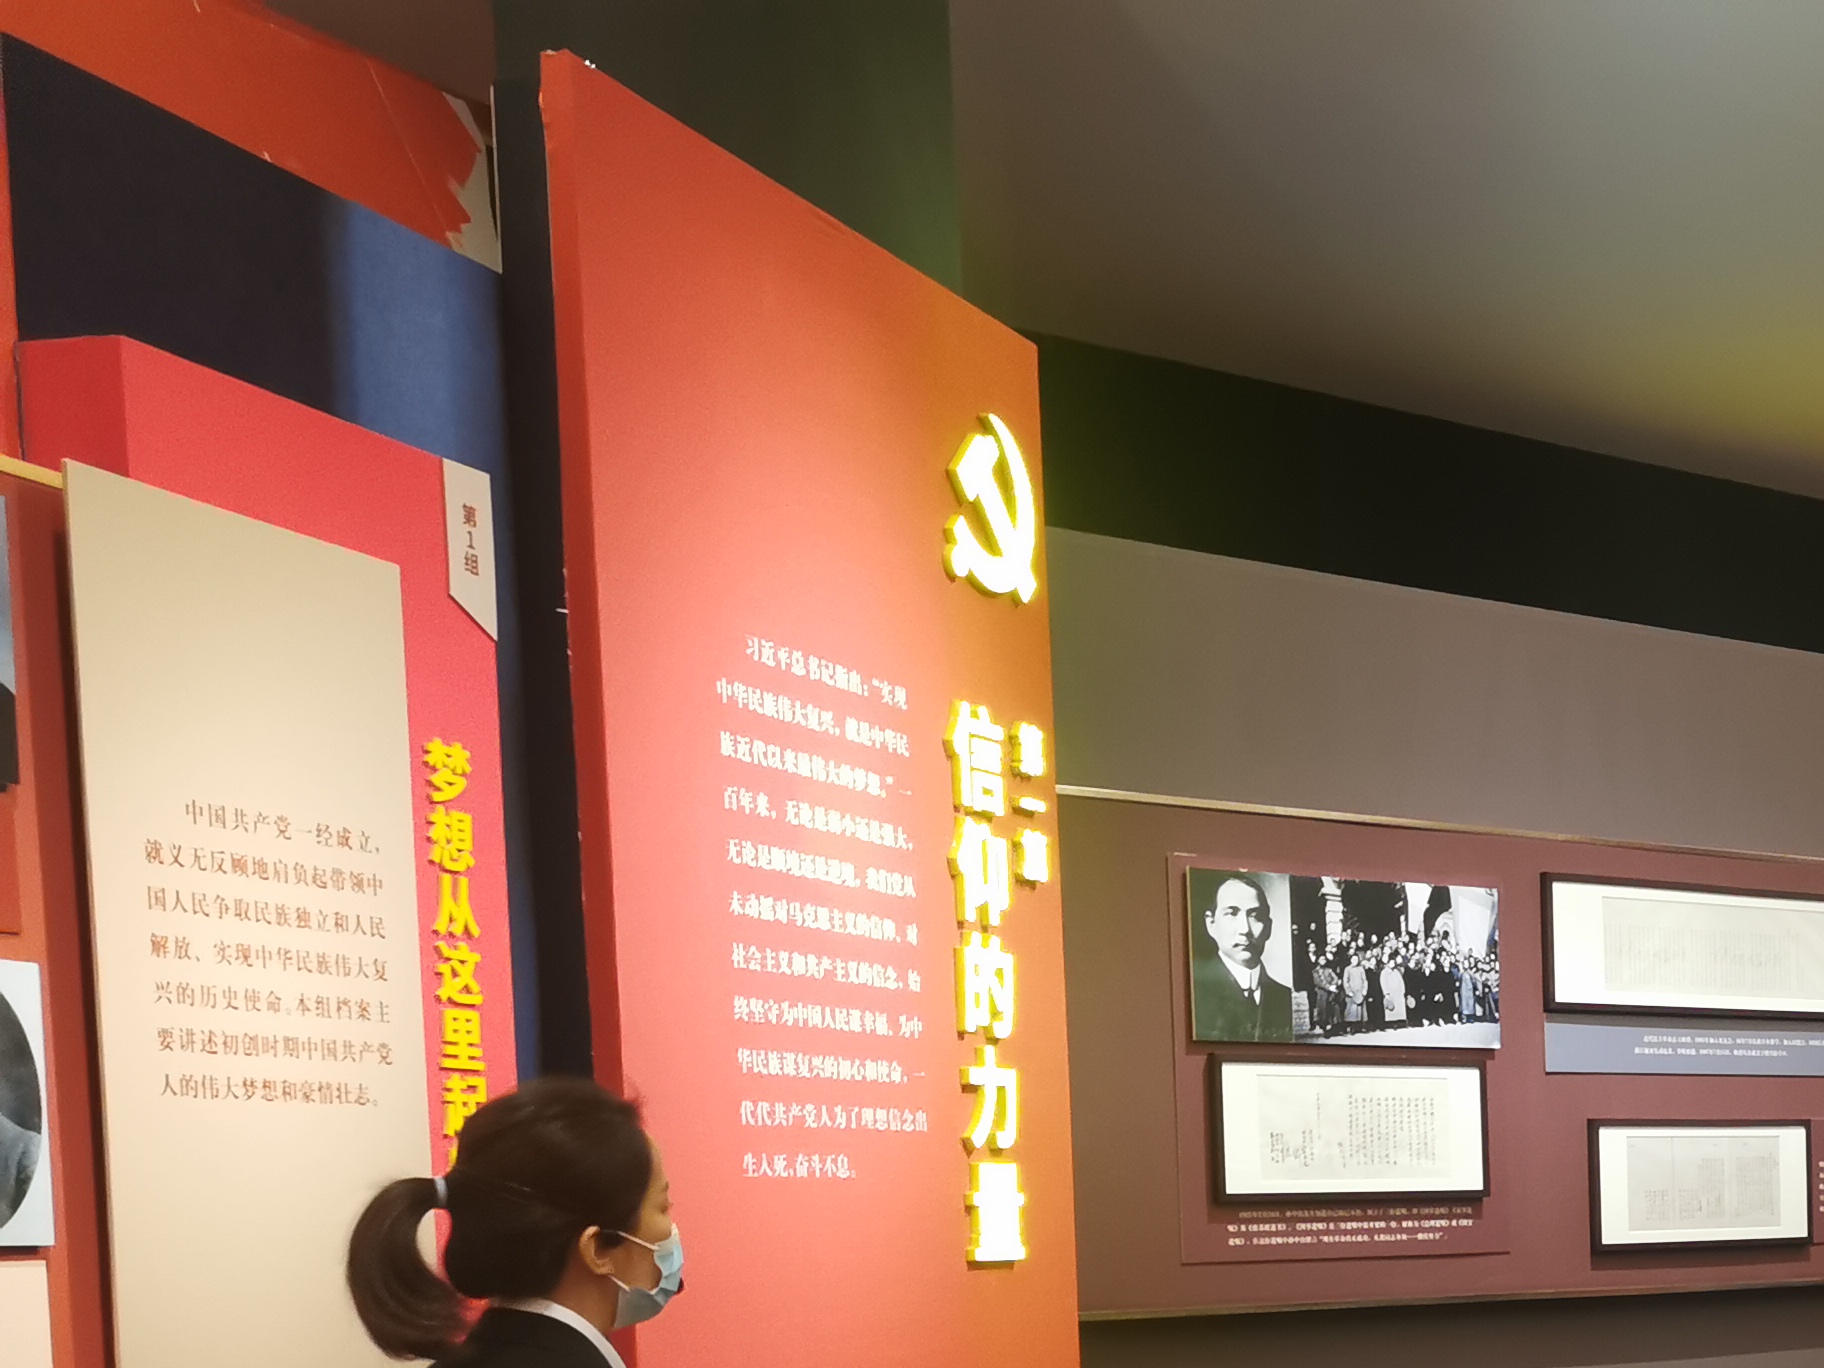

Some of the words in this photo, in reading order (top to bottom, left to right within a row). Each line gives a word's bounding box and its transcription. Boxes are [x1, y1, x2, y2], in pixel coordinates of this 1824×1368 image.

[462, 503, 480, 576] 第1组
[185, 798, 380, 855] 中国共产党一经成立，
[144, 838, 384, 897] 就义无反顾地肩负起带领中
[146, 885, 387, 940] 国人民争取民族独立和人民
[150, 932, 389, 982] 解放、实现中华民族伟大复
[422, 738, 487, 1169] 梦想从这里起
[153, 981, 391, 1024] 兴的历史使命。本组档案主
[733, 995, 923, 1040] 终坚守为中国人民谋幸福、为中
[157, 1026, 393, 1066] 要讲述初创时期中国共产党
[737, 1047, 926, 1084] 华民族谋复兴的初心和使命，一
[160, 1073, 379, 1107] 人的伟大梦想和豪情壮志。
[739, 1100, 928, 1132] 代代共产党人为了理想信念出
